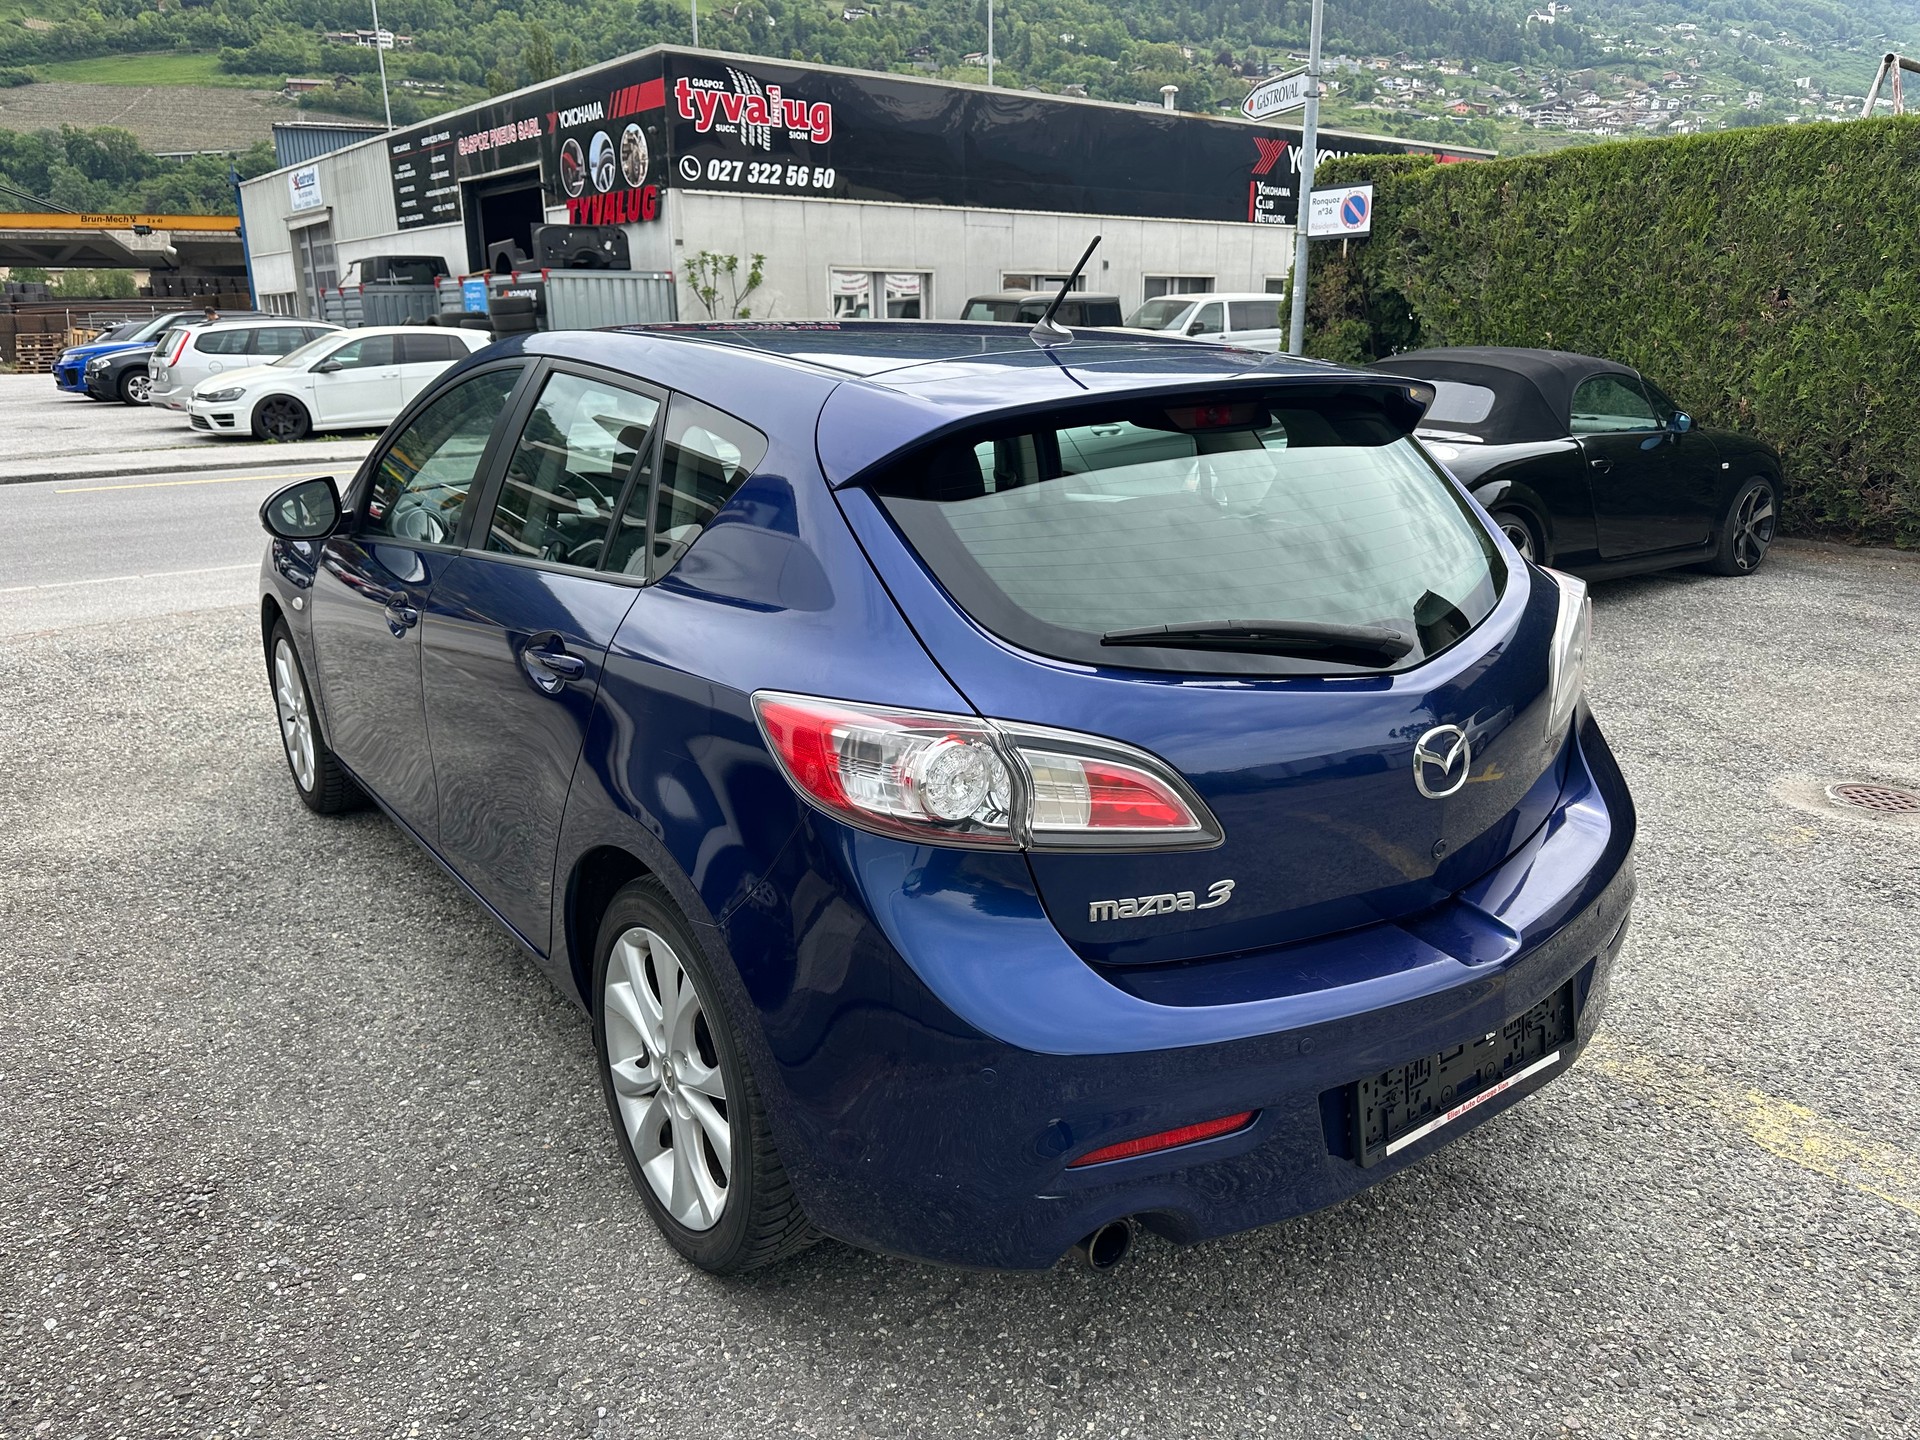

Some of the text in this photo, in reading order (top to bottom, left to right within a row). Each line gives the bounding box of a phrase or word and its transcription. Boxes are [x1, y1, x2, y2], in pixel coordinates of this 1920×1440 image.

[692, 78, 724, 90] GASPOZ
[1256, 82, 1300, 110] GASTROVAL
[558, 100, 604, 129] YOKOHAMA
[674, 77, 832, 144] tyvalug
[772, 88, 781, 126] PNEUS
[458, 116, 542, 156] GASPOZ PNEUS SARL
[715, 123, 738, 133] SUCC.
[788, 131, 808, 140] SION
[707, 158, 835, 189] 027 322 56 50
[1255, 195, 1274, 210] CLUB
[1256, 182, 1291, 198] YOKOHAMA
[1312, 197, 1340, 206] Ronquoz
[80, 215, 129, 223] Brun-Mech
[566, 184, 658, 226] TYVALUG
[1254, 209, 1286, 224] NETWORK
[1196, 878, 1236, 910] 3
[1447, 1083, 1508, 1120] Elias Auto Garage Sion
